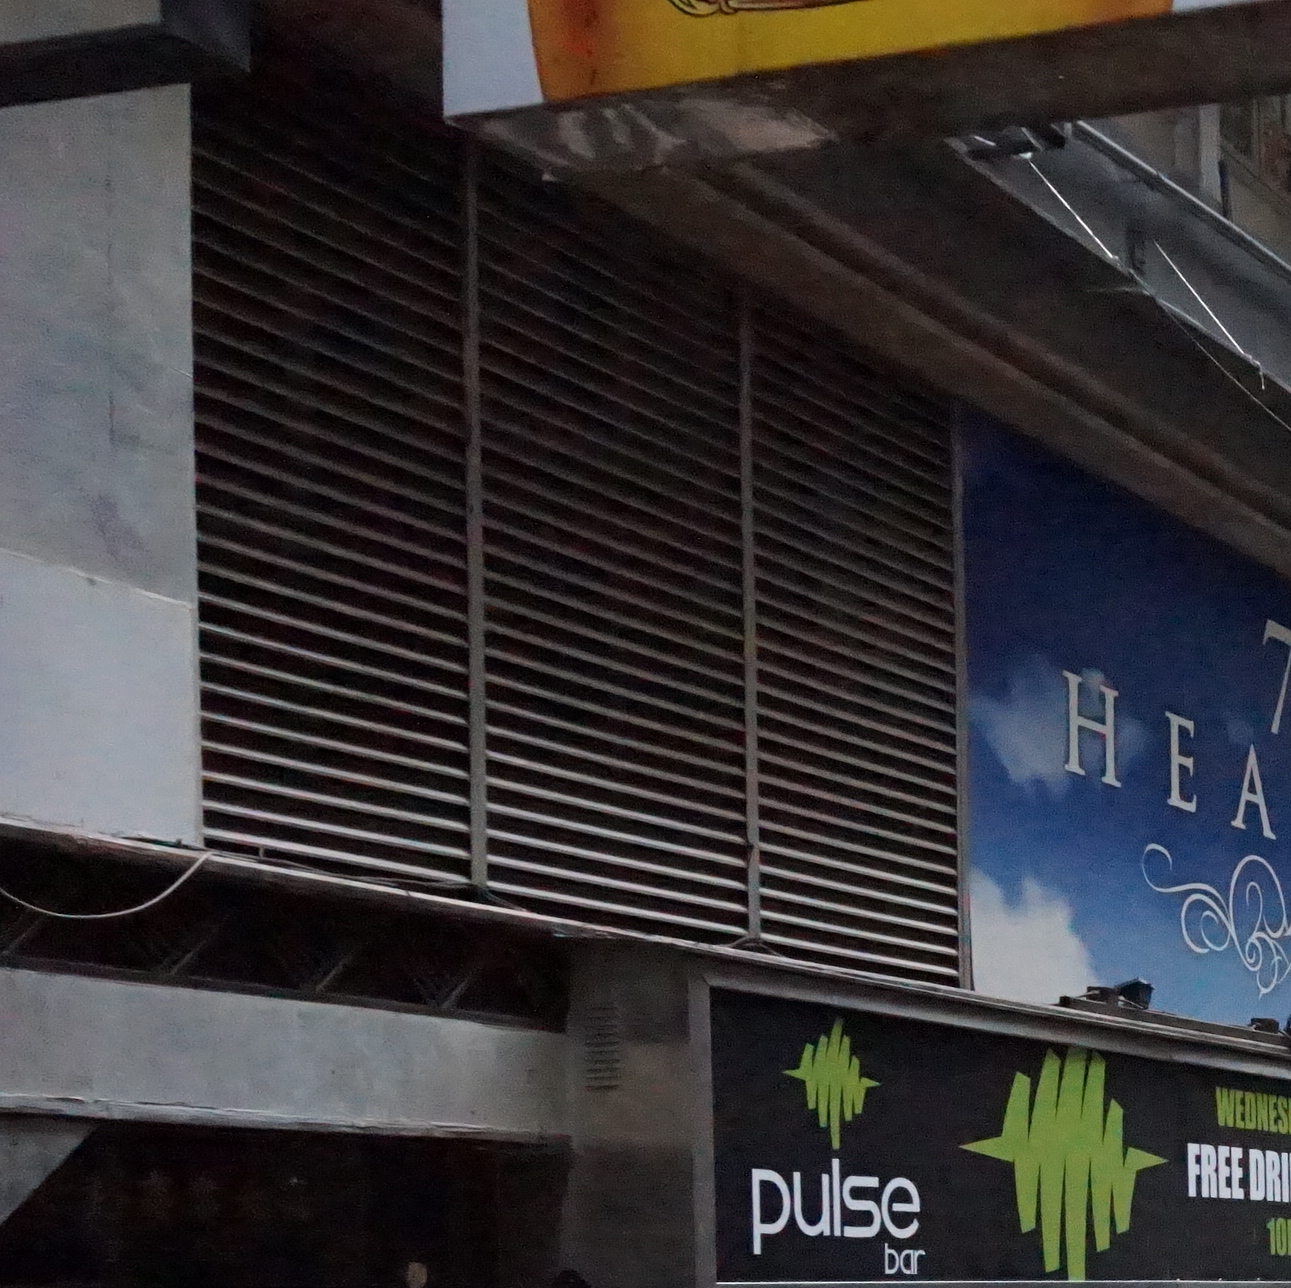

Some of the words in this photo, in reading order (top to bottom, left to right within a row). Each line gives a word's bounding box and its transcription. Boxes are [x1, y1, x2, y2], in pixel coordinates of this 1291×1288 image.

[1187, 1142, 1244, 1200] FREE
[751, 1158, 921, 1255] pulse
[884, 1243, 926, 1275] bar
